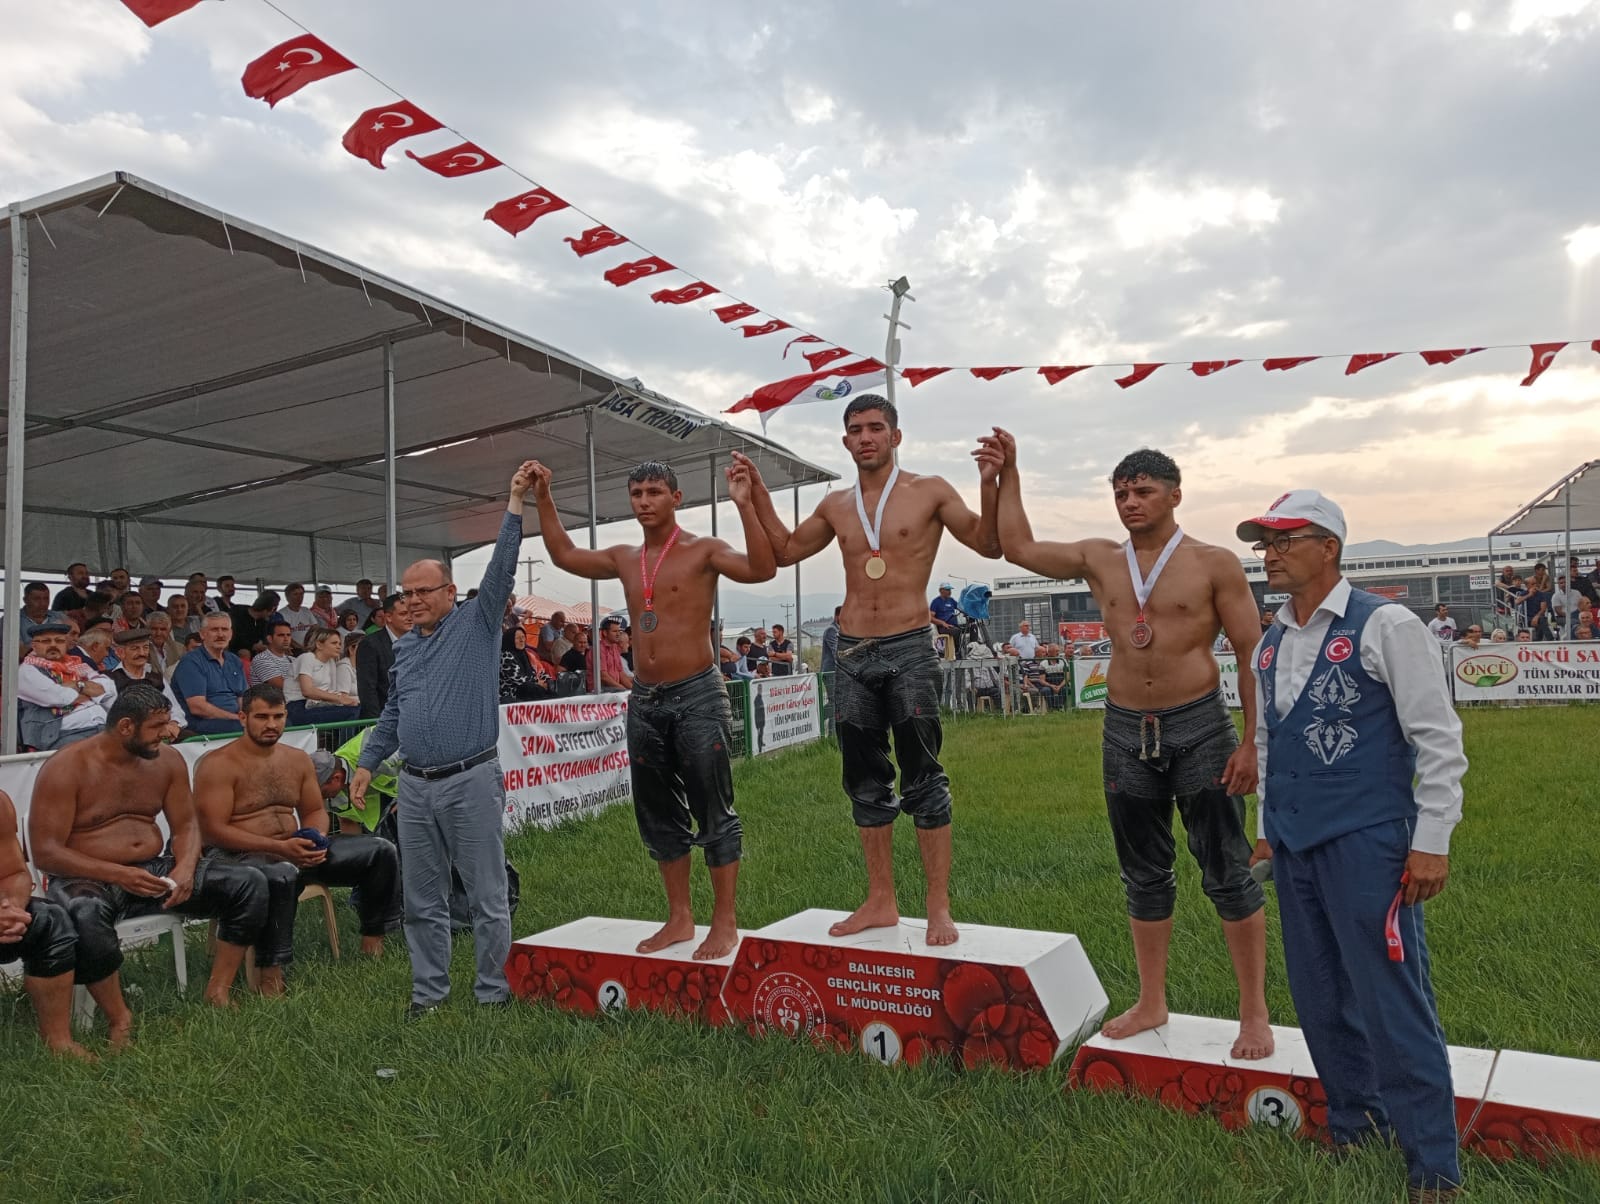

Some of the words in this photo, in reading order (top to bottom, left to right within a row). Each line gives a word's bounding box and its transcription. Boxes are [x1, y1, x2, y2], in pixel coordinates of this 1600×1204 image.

[1517, 647, 1569, 663] ÖNCÜ
[1463, 661, 1509, 676] ÖNCÜ
[1523, 667, 1550, 679] TÜM
[1517, 684, 1582, 697] BAŞARILAR
[507, 703, 579, 725] KIRKPINAR'IN
[581, 702, 618, 721] EFSANE
[521, 735, 555, 756] SAYIN
[555, 727, 608, 752] SEYFETTİN
[527, 767, 542, 787] ER
[543, 757, 600, 784] MEYDANINA
[525, 801, 551, 821] GÖNEN
[849, 962, 916, 980] BALIKESİR
[606, 985, 619, 1011] 2
[827, 976, 881, 994] GENÇLİK
[885, 984, 902, 997] VE
[905, 987, 941, 1001] SPOR
[836, 993, 848, 1007] İL
[851, 996, 932, 1018] MÜDÜRLÜĞÜ
[873, 1031, 886, 1061] 1
[1262, 1096, 1284, 1128] 3
